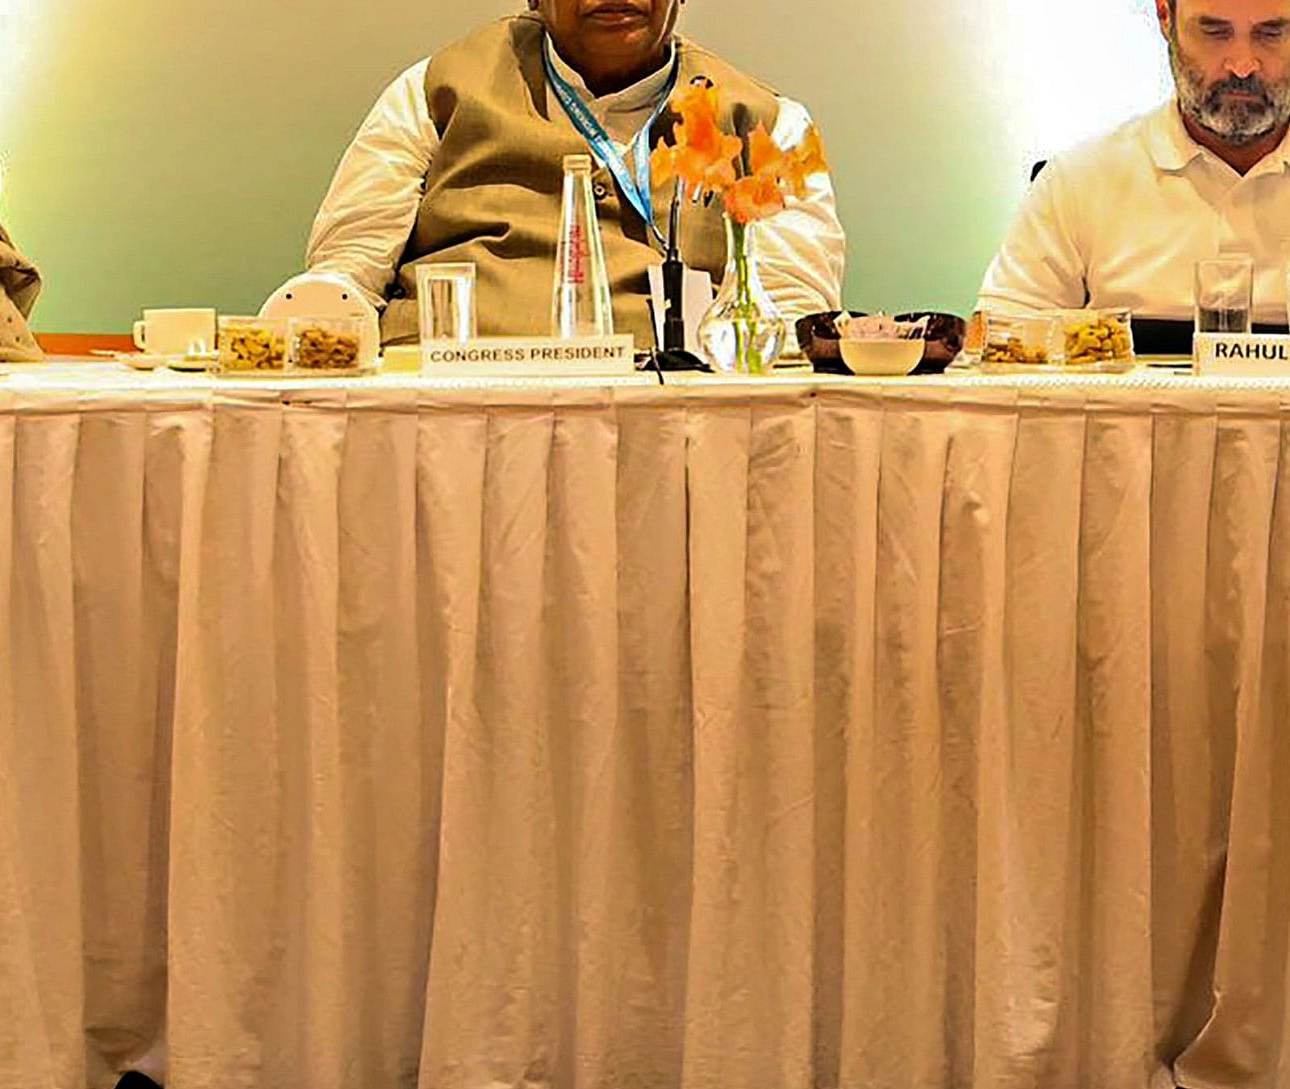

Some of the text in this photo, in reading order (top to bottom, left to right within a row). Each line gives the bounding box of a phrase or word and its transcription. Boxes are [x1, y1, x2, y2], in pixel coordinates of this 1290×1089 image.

[430, 346, 625, 362] CONGRESS PRESIDENT
[1215, 342, 1288, 360] RAHUL
